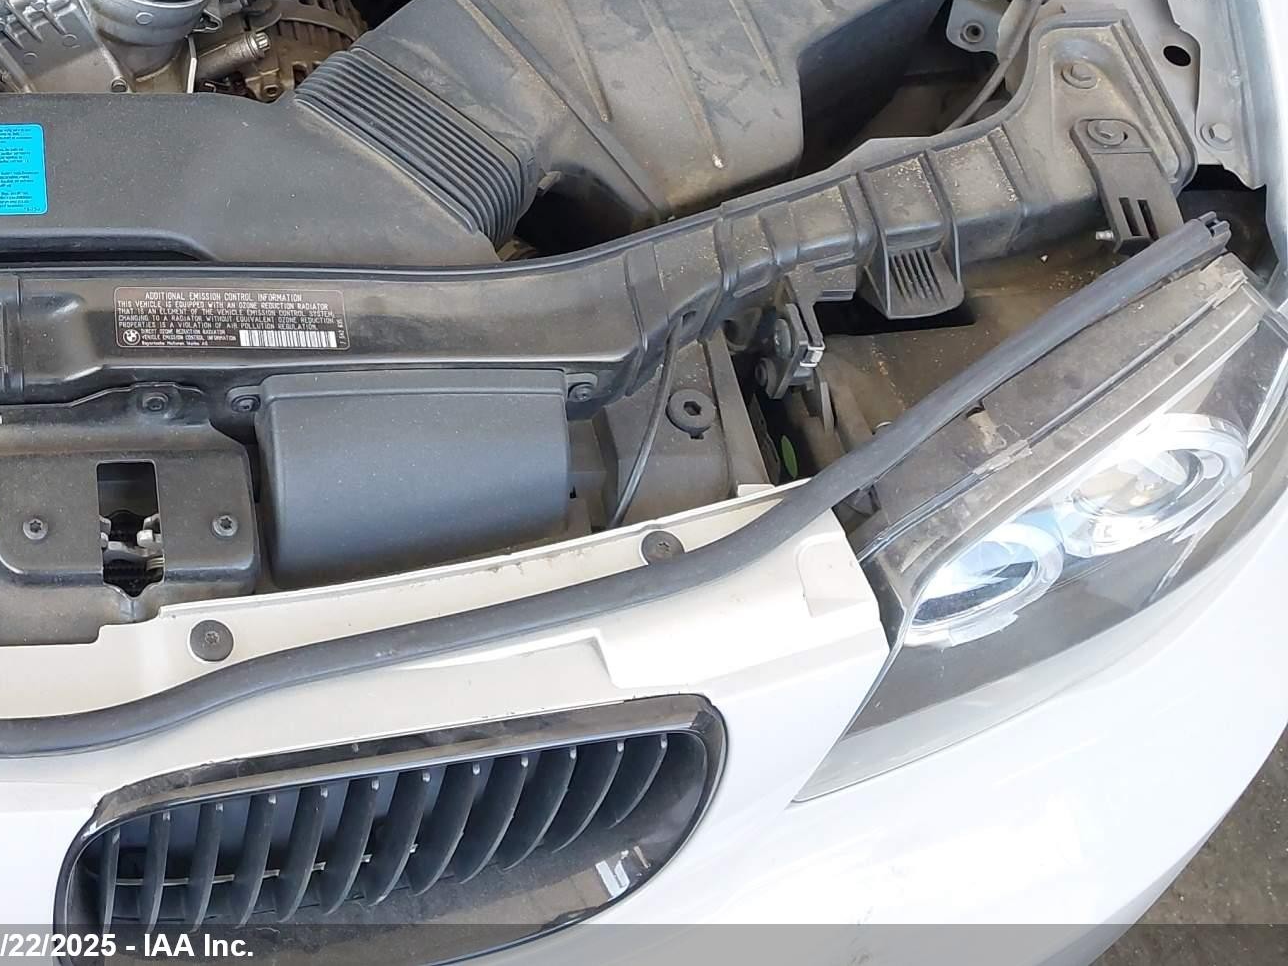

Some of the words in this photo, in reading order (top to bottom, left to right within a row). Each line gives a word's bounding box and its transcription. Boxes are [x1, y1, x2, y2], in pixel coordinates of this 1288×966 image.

[145, 292, 185, 300] ADDITIONAL
[189, 292, 220, 300] EMISSION
[224, 292, 252, 301] CONTROL
[258, 293, 302, 301] INFORMATION
[175, 301, 204, 309] EQUIPPED
